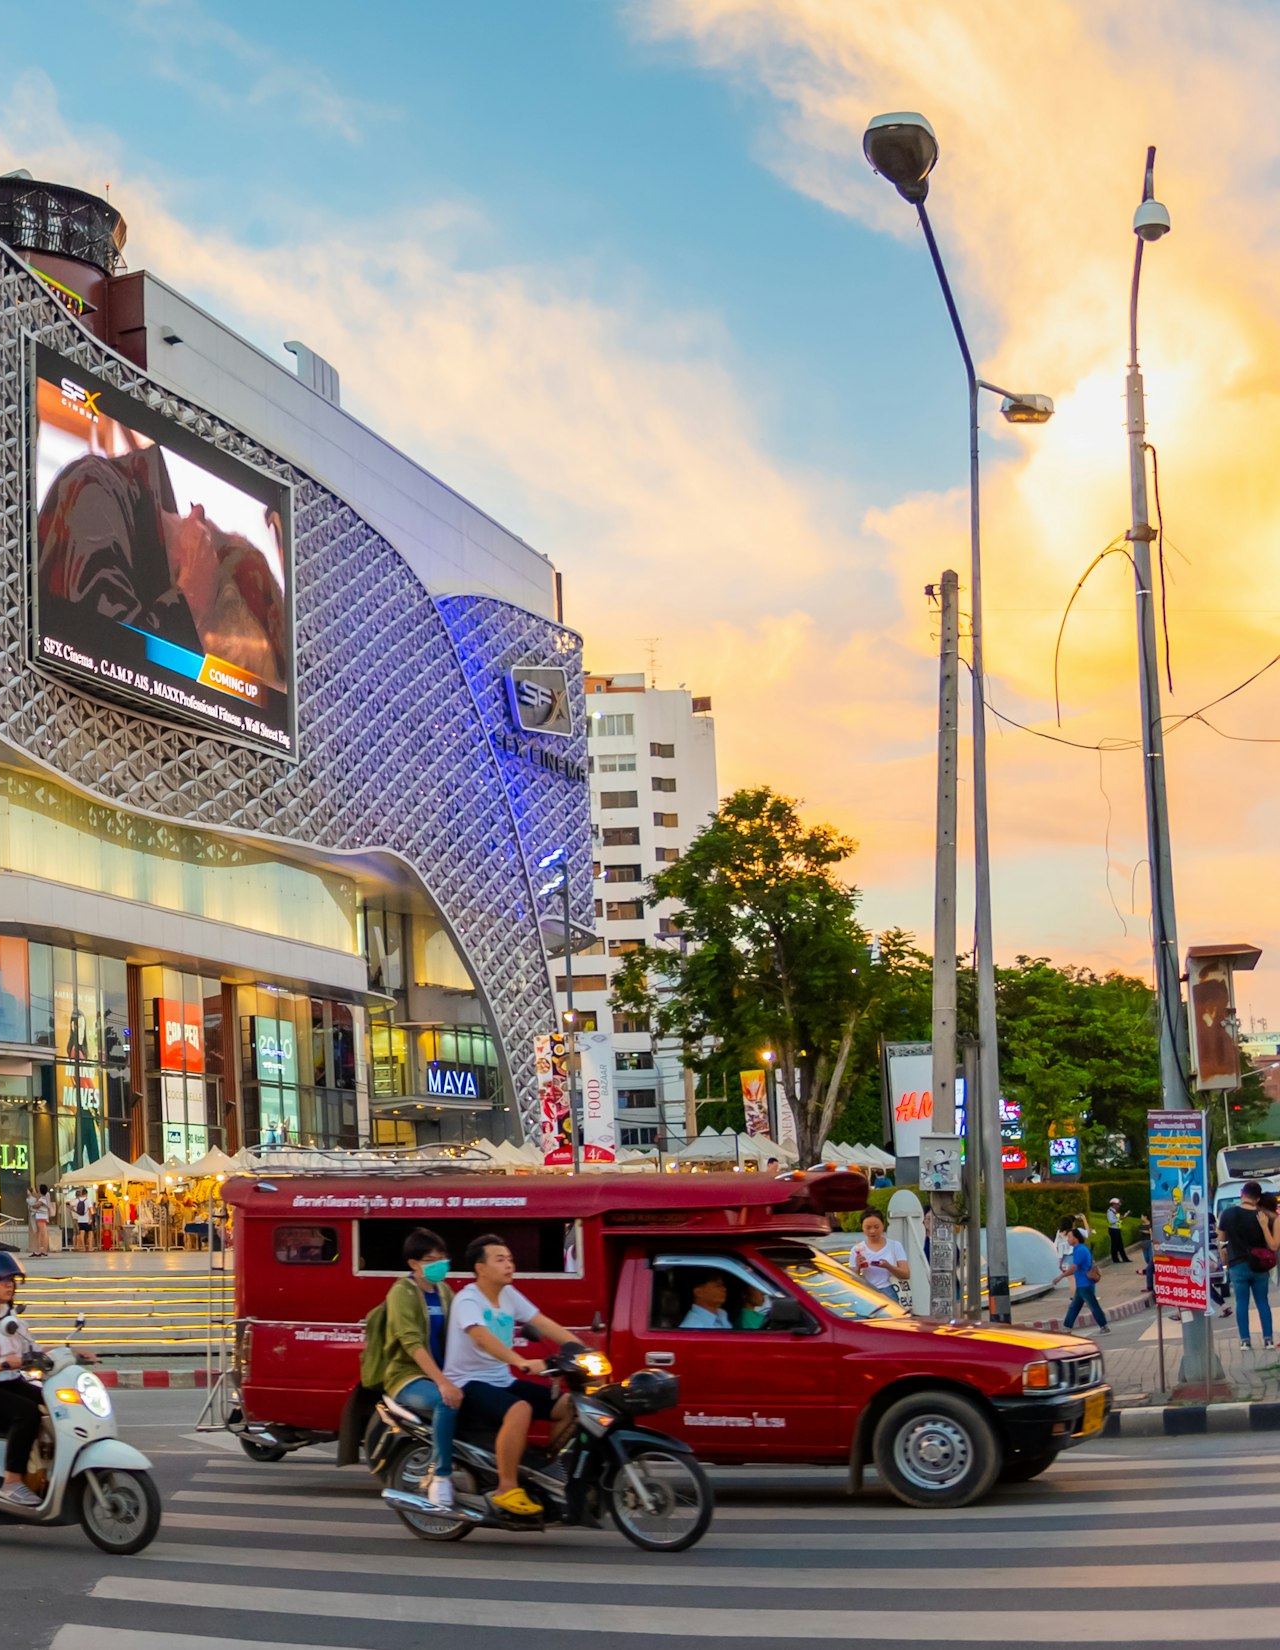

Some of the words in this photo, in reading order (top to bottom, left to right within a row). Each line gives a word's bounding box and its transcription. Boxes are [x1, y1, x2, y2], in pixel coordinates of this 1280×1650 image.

[61, 377, 101, 415] SFX
[43, 636, 63, 658] SFX
[208, 668, 245, 694] COMING
[244, 681, 259, 698] UP
[427, 1068, 478, 1096] MAYA
[600, 1064, 608, 1097] BAZAAR
[587, 1078, 602, 1120] FOOD
[390, 1197, 404, 1208] 30
[446, 1197, 460, 1207] 30
[1154, 1264, 1178, 1274] TOYOTA
[1154, 1285, 1207, 1300] 053-998-555
